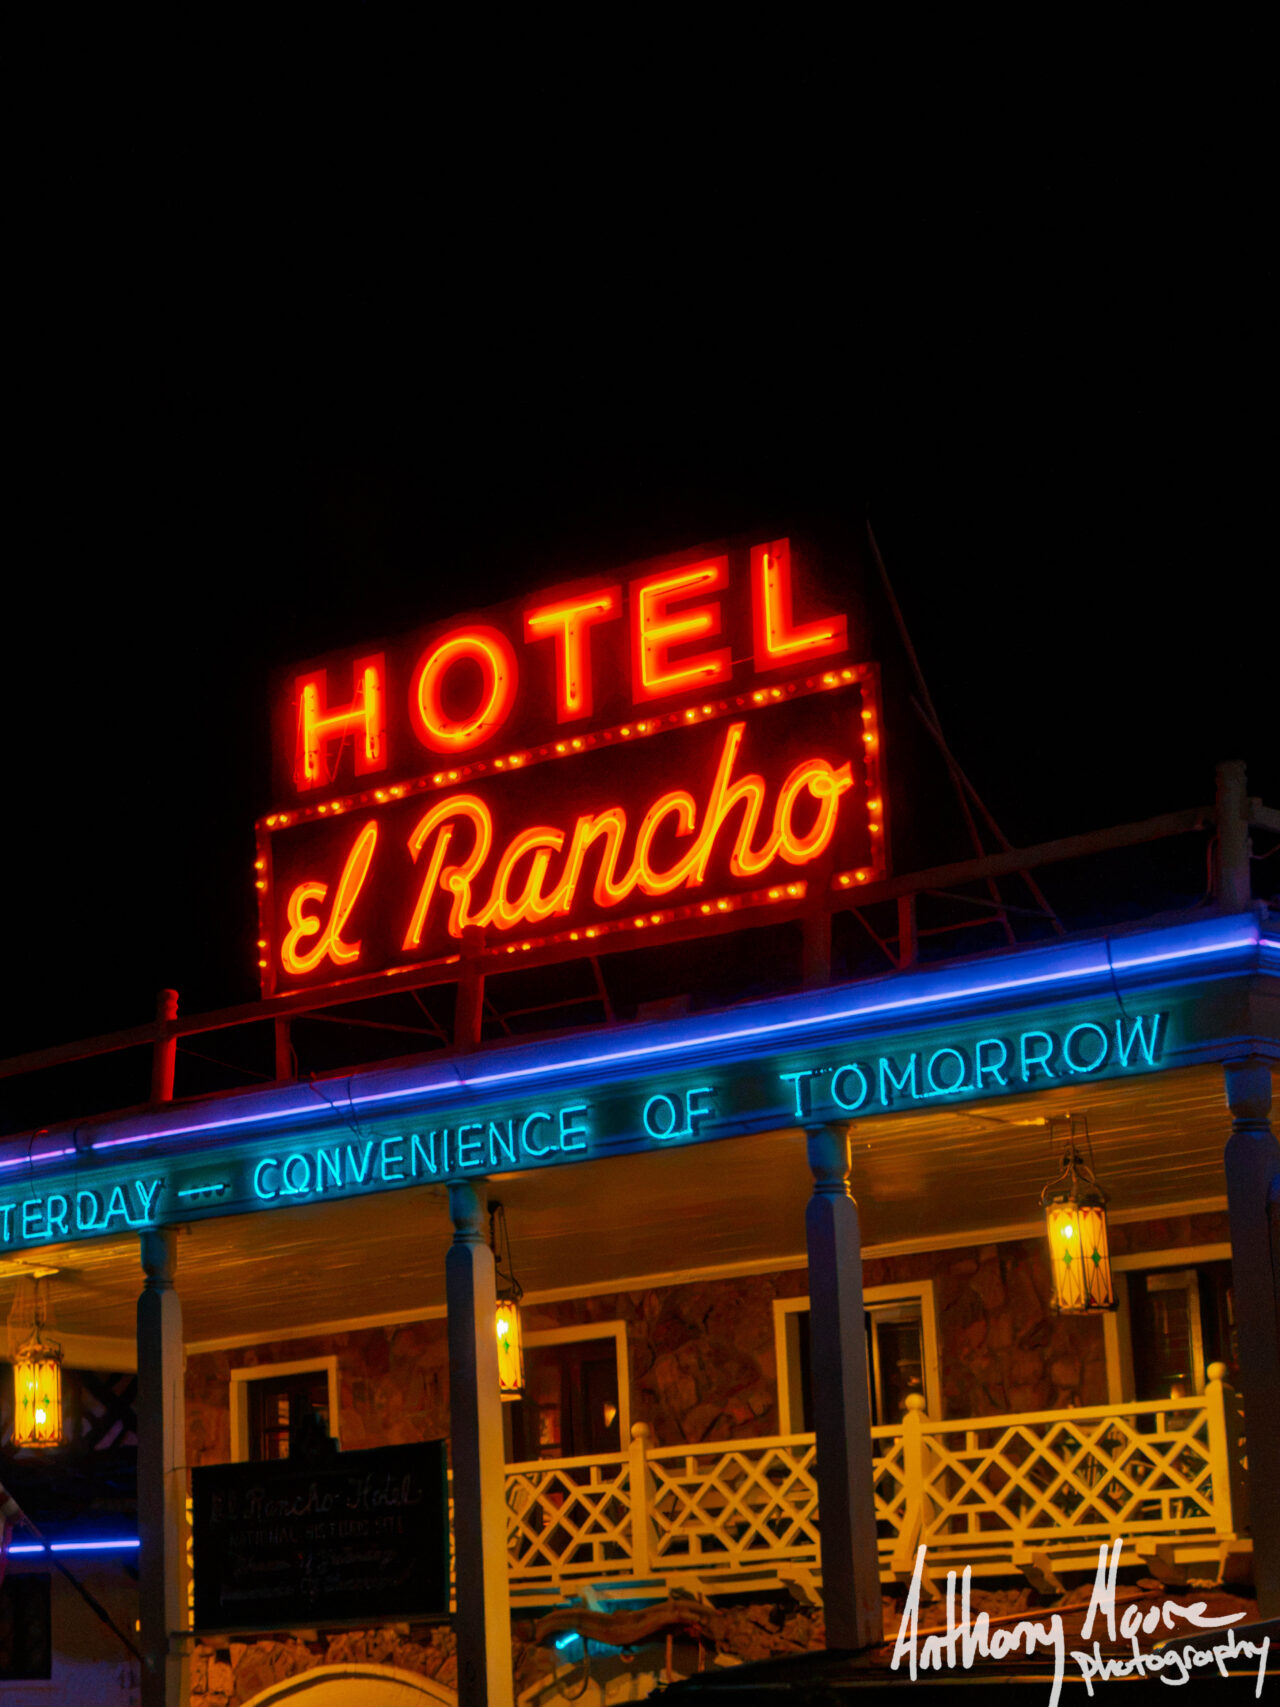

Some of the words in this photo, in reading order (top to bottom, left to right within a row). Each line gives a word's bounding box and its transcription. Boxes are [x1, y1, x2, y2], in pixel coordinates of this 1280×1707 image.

[294, 537, 848, 792] HOTEL
[279, 820, 379, 975] El
[403, 721, 854, 950] Rancho
[253, 1105, 589, 1200] CONVENIENCE
[643, 1087, 714, 1139] OF
[779, 1013, 1168, 1117] TOMORROW
